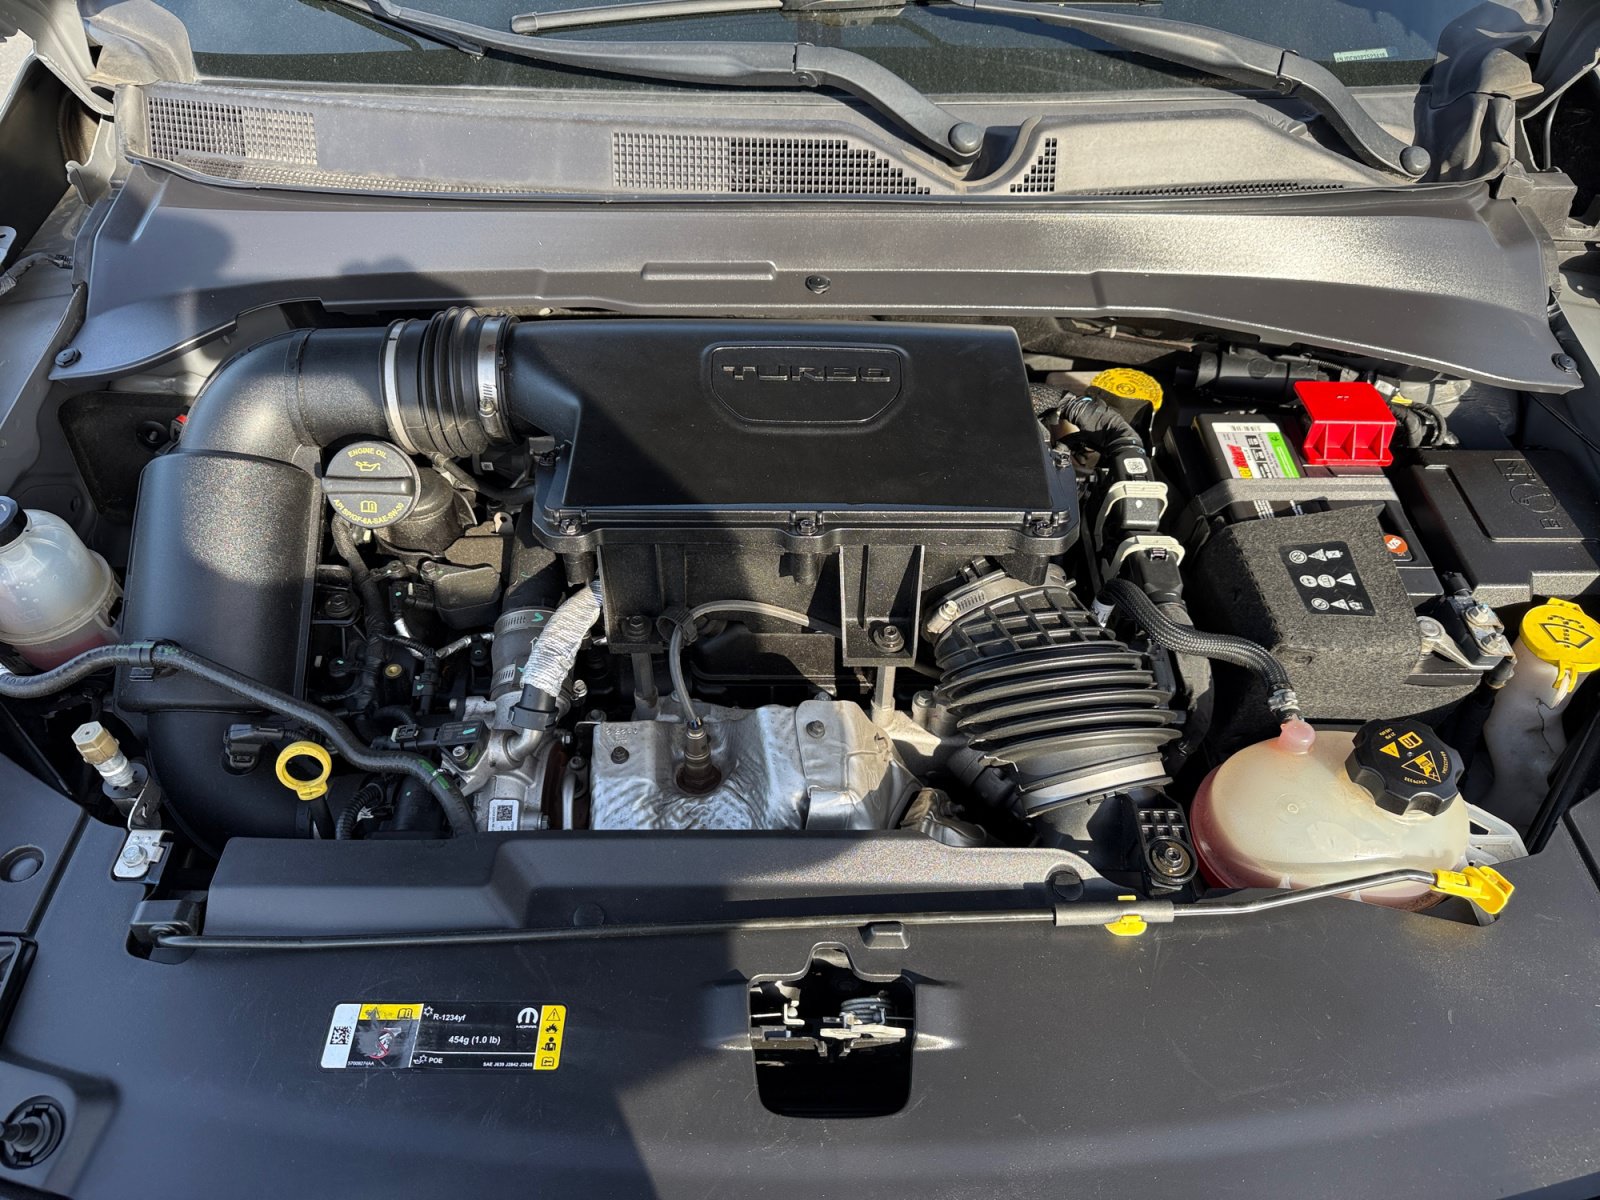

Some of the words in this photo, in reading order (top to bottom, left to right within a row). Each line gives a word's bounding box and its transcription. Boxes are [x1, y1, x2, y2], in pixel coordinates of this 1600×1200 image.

[722, 365, 891, 382] TURBO
[347, 447, 374, 458] ENGINE
[375, 447, 387, 459] OIL
[333, 499, 344, 511] API
[433, 1012, 466, 1023] R-1234yf
[448, 1036, 470, 1046] 454g
[471, 1035, 487, 1045] (1.0
[488, 1035, 501, 1045] lb)
[428, 1056, 444, 1064] POE
